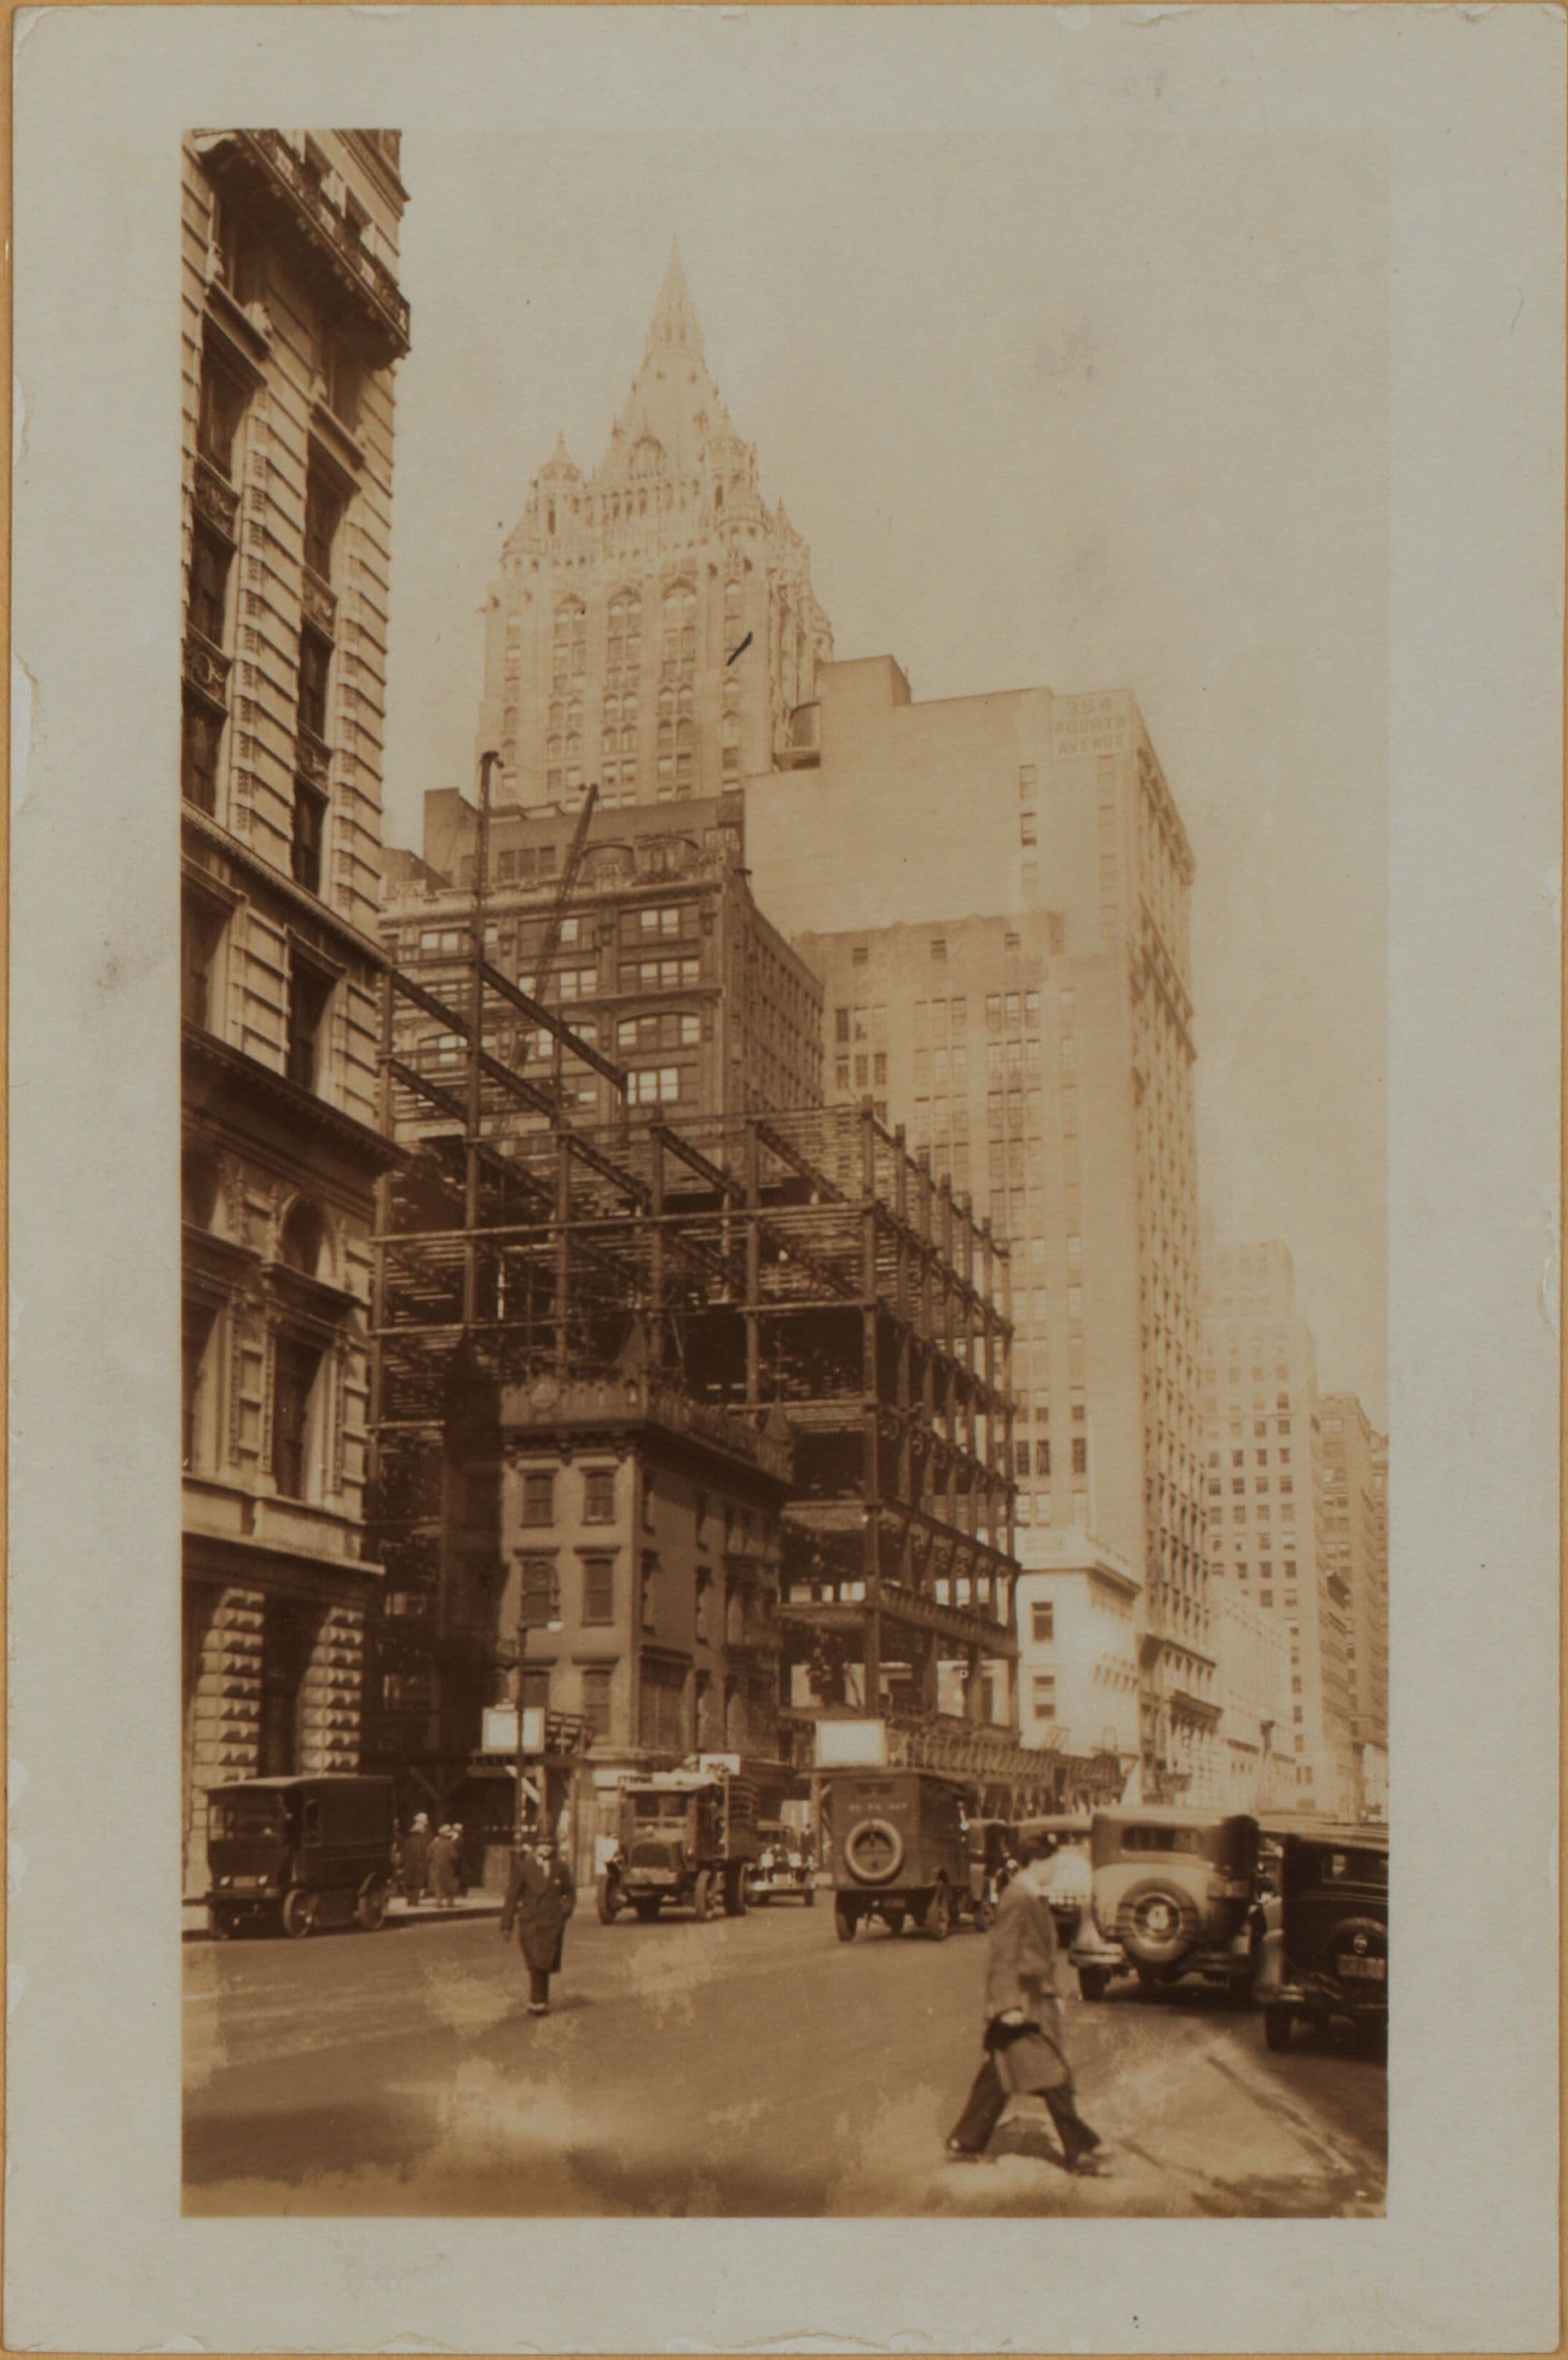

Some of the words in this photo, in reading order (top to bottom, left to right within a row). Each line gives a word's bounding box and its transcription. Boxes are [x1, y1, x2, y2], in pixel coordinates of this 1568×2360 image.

[1066, 697, 1112, 716] 354
[1055, 716, 1125, 735] FOURTH
[1058, 734, 1124, 754] AVENUE
